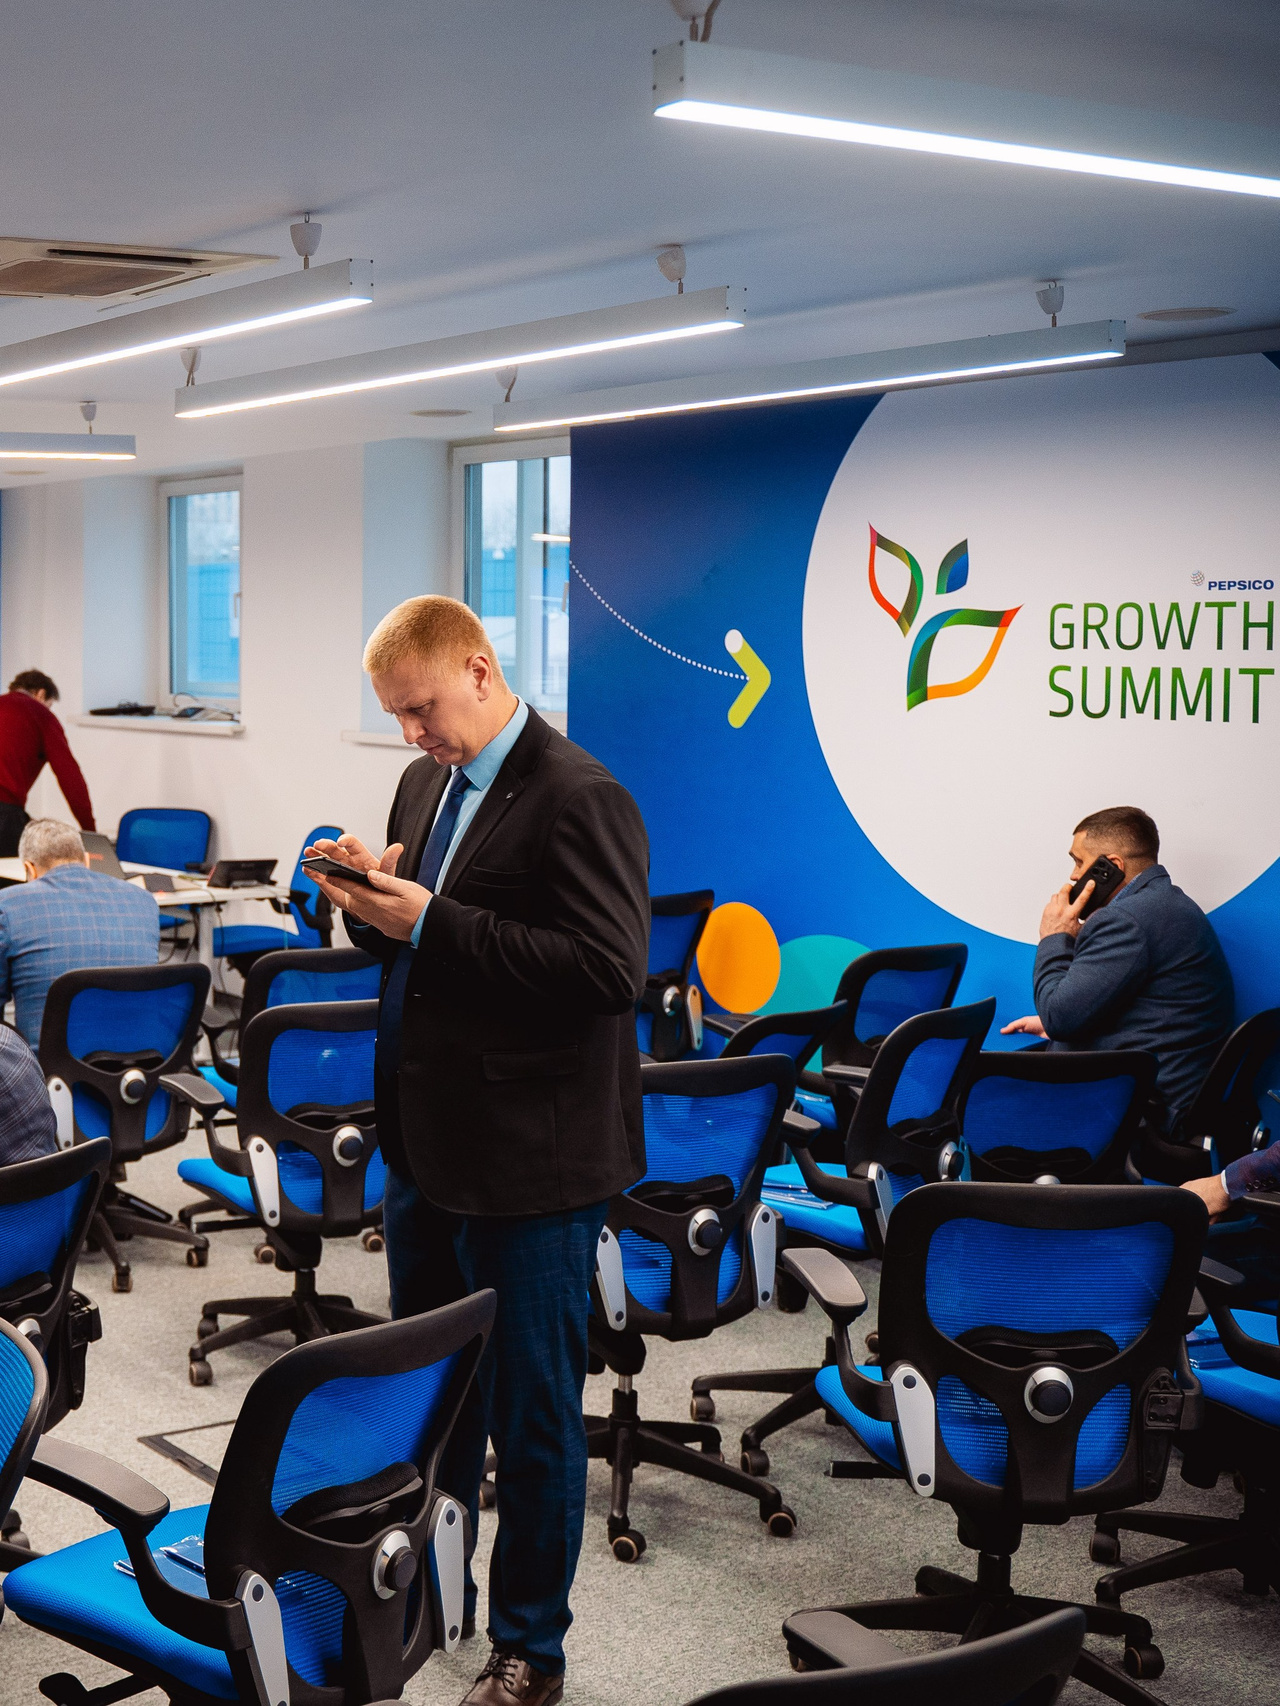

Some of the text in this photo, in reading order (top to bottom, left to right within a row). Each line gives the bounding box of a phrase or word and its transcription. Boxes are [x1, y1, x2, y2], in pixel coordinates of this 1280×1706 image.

[1208, 579, 1275, 591] PEPSICO
[1048, 600, 1274, 651] GROWTH
[1048, 664, 1275, 724] SUMMIT
